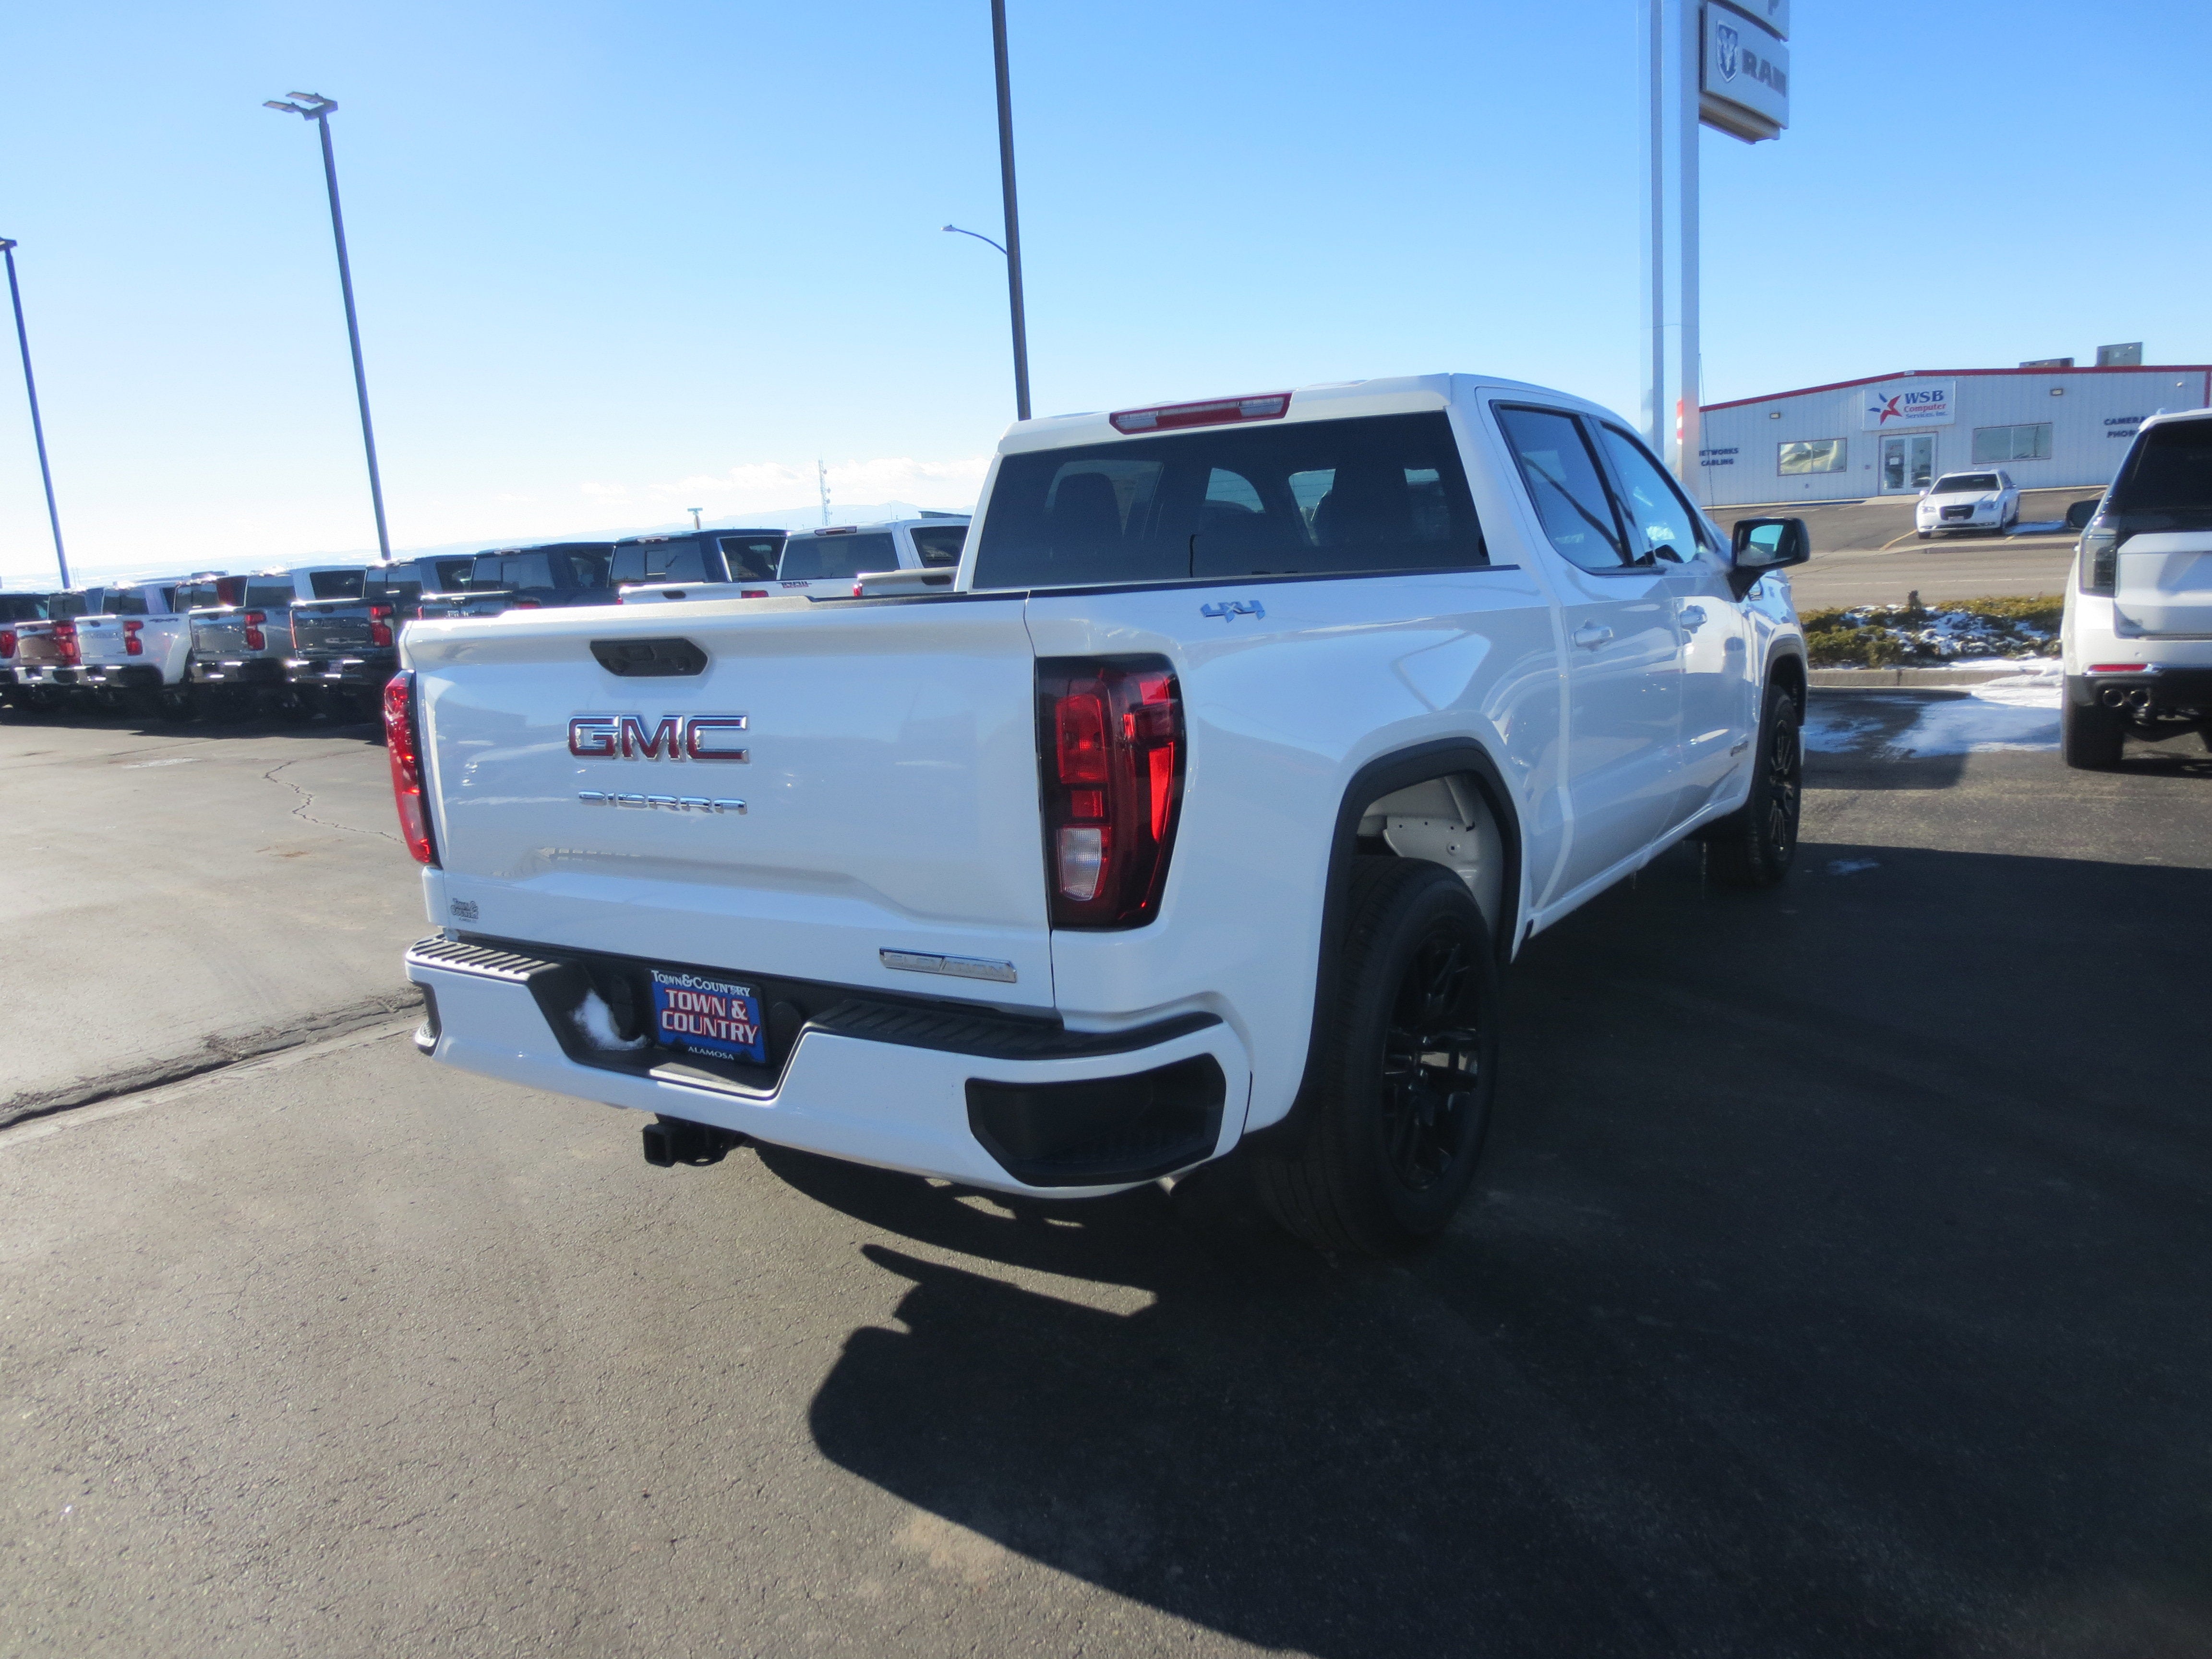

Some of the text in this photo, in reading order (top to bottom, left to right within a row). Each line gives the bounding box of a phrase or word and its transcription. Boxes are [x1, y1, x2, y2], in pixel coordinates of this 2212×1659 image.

[1741, 48, 1787, 97] RAM
[1903, 403, 1947, 413] Computer
[1904, 389, 1944, 404] WSB
[566, 714, 751, 760] GMC
[663, 988, 749, 1021] TOWN &
[661, 1010, 760, 1045] COUNTRY
[688, 1046, 734, 1060] ALAMOSA
